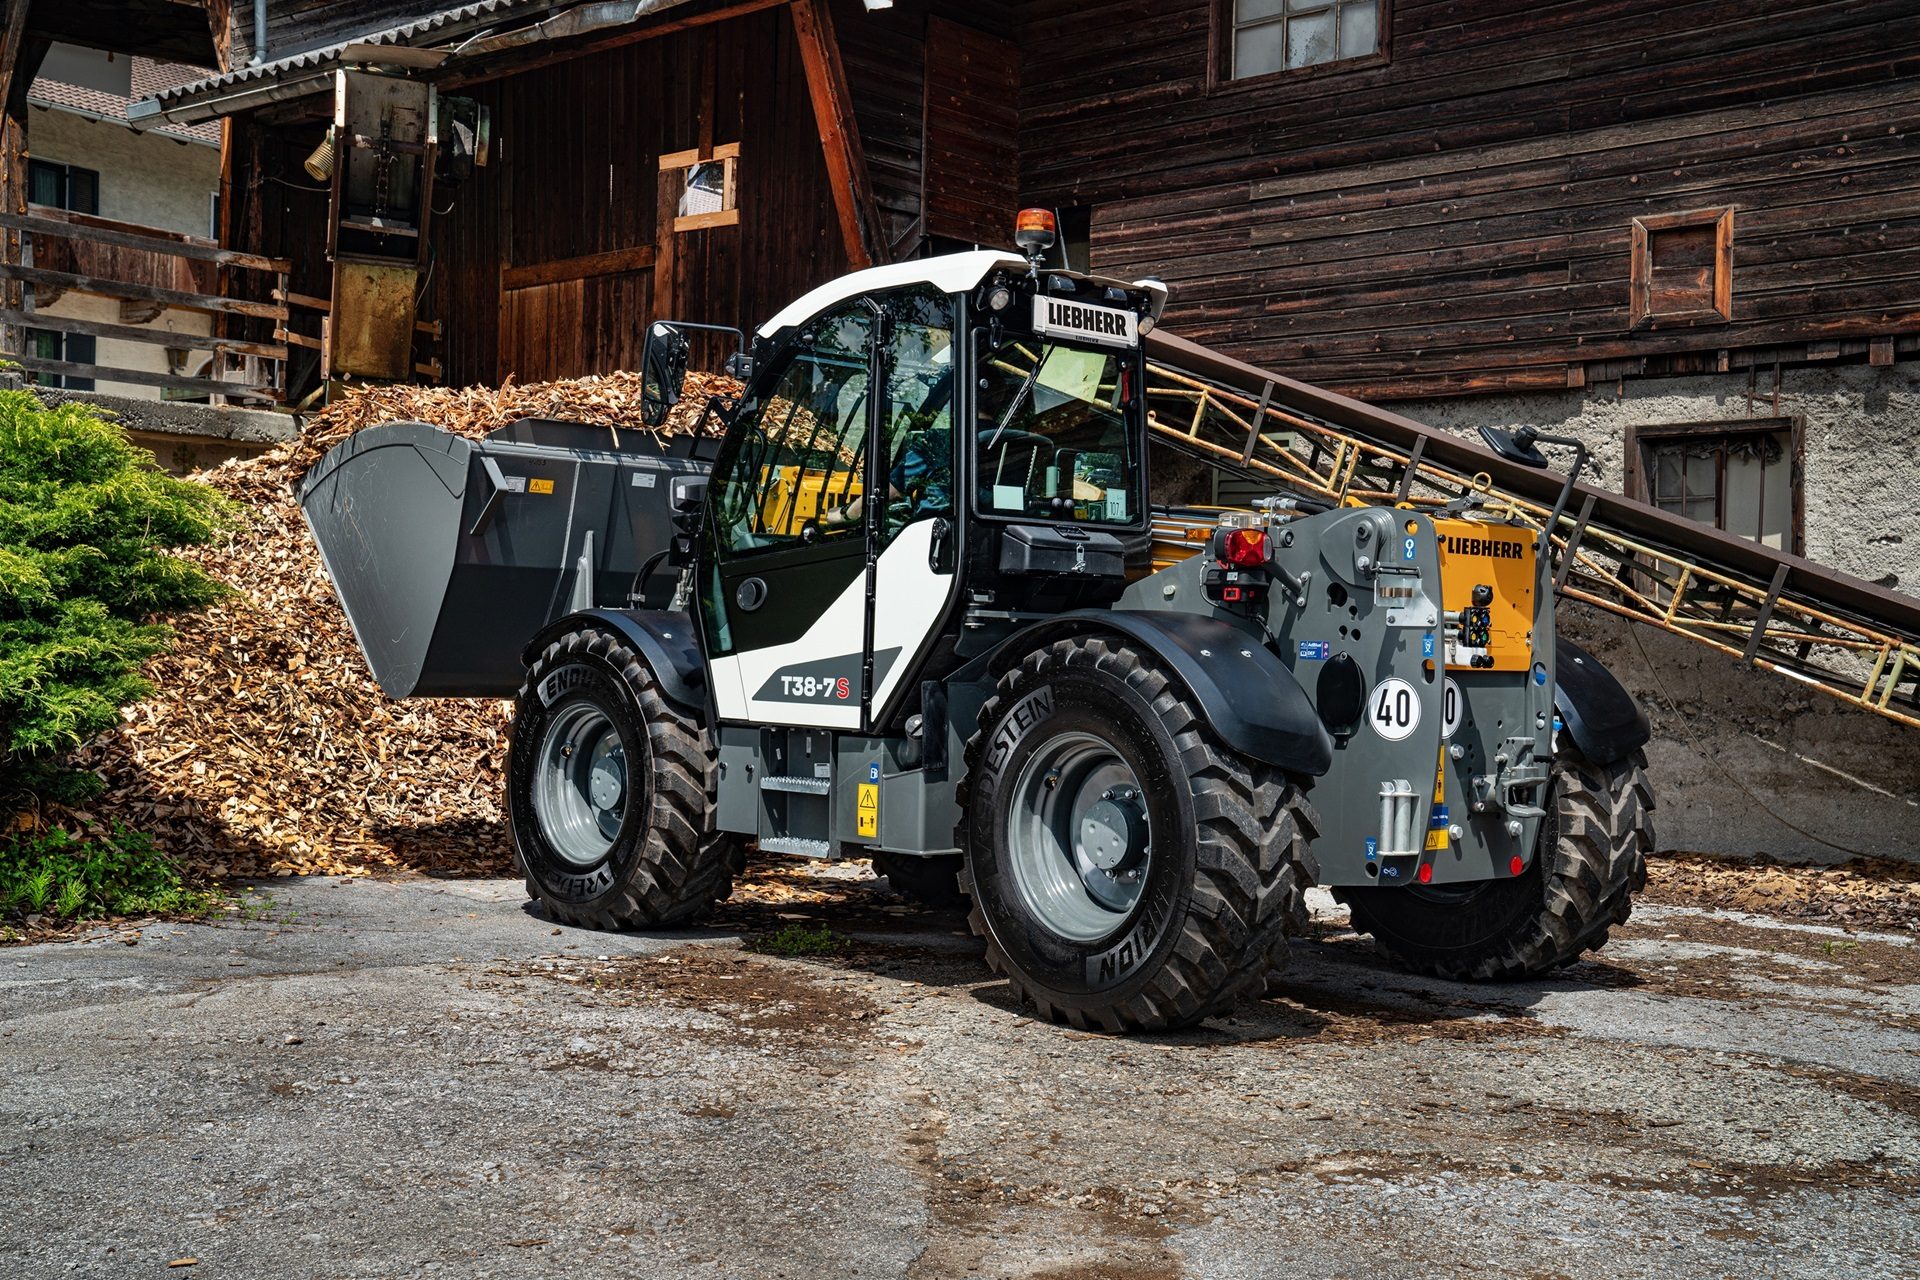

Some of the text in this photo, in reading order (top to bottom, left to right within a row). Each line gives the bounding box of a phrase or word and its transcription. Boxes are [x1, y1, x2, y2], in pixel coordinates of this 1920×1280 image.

[1048, 302, 1127, 336] LIEBHERR
[1448, 537, 1523, 559] LIEBHERR
[781, 676, 850, 699] T38-7S
[1376, 688, 1411, 727] 40
